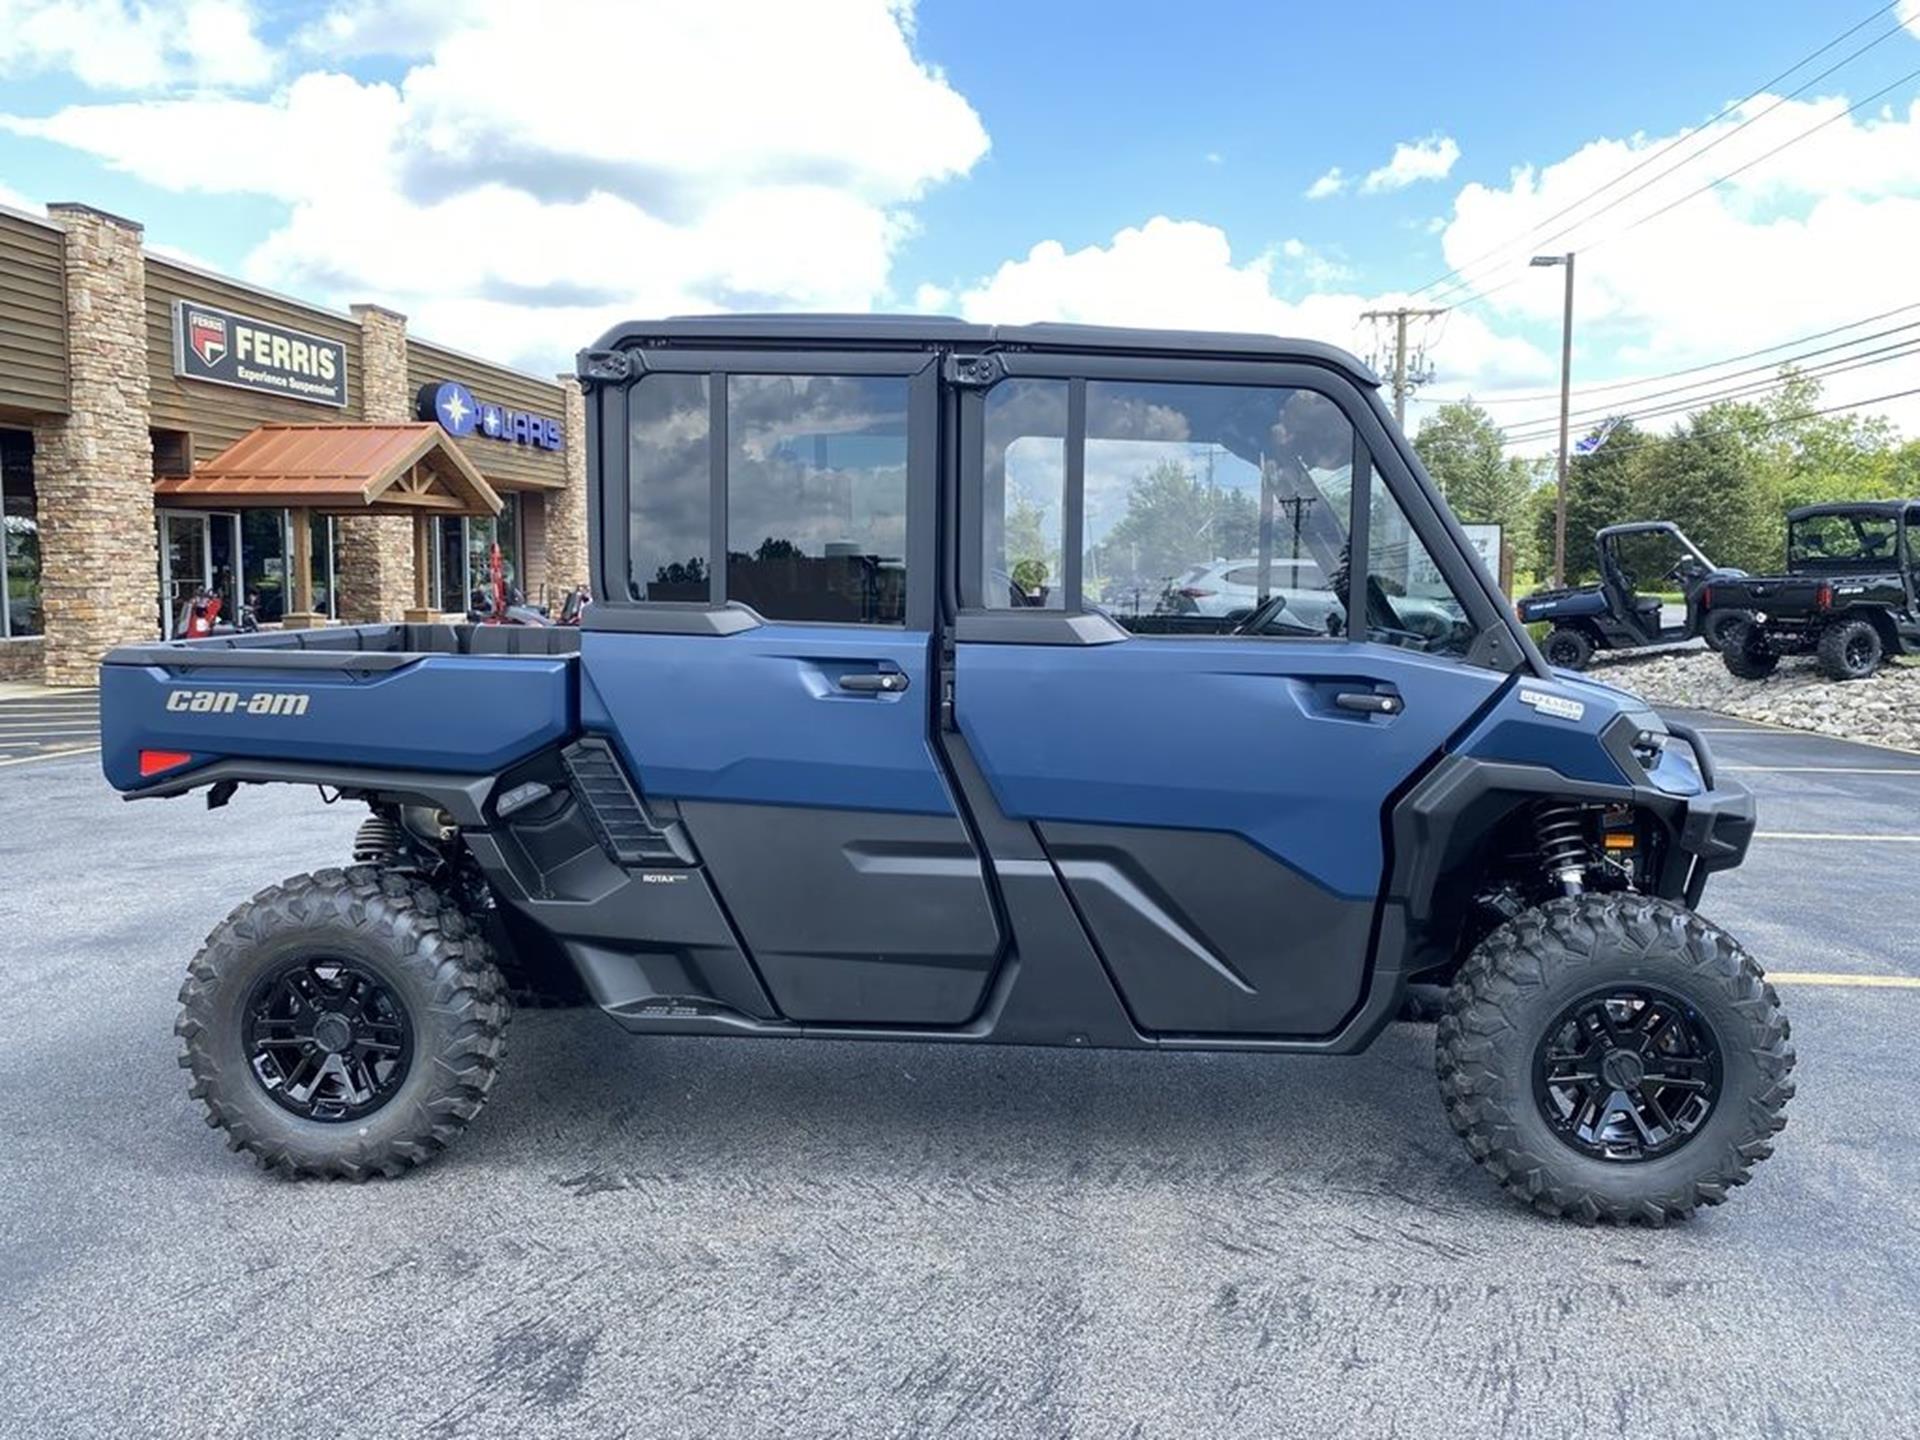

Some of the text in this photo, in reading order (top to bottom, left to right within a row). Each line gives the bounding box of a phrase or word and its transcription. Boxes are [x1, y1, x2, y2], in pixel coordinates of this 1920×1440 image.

[236, 326, 335, 380] FERRIS
[237, 366, 336, 396] Experience Suspension
[166, 690, 310, 714] can-am
